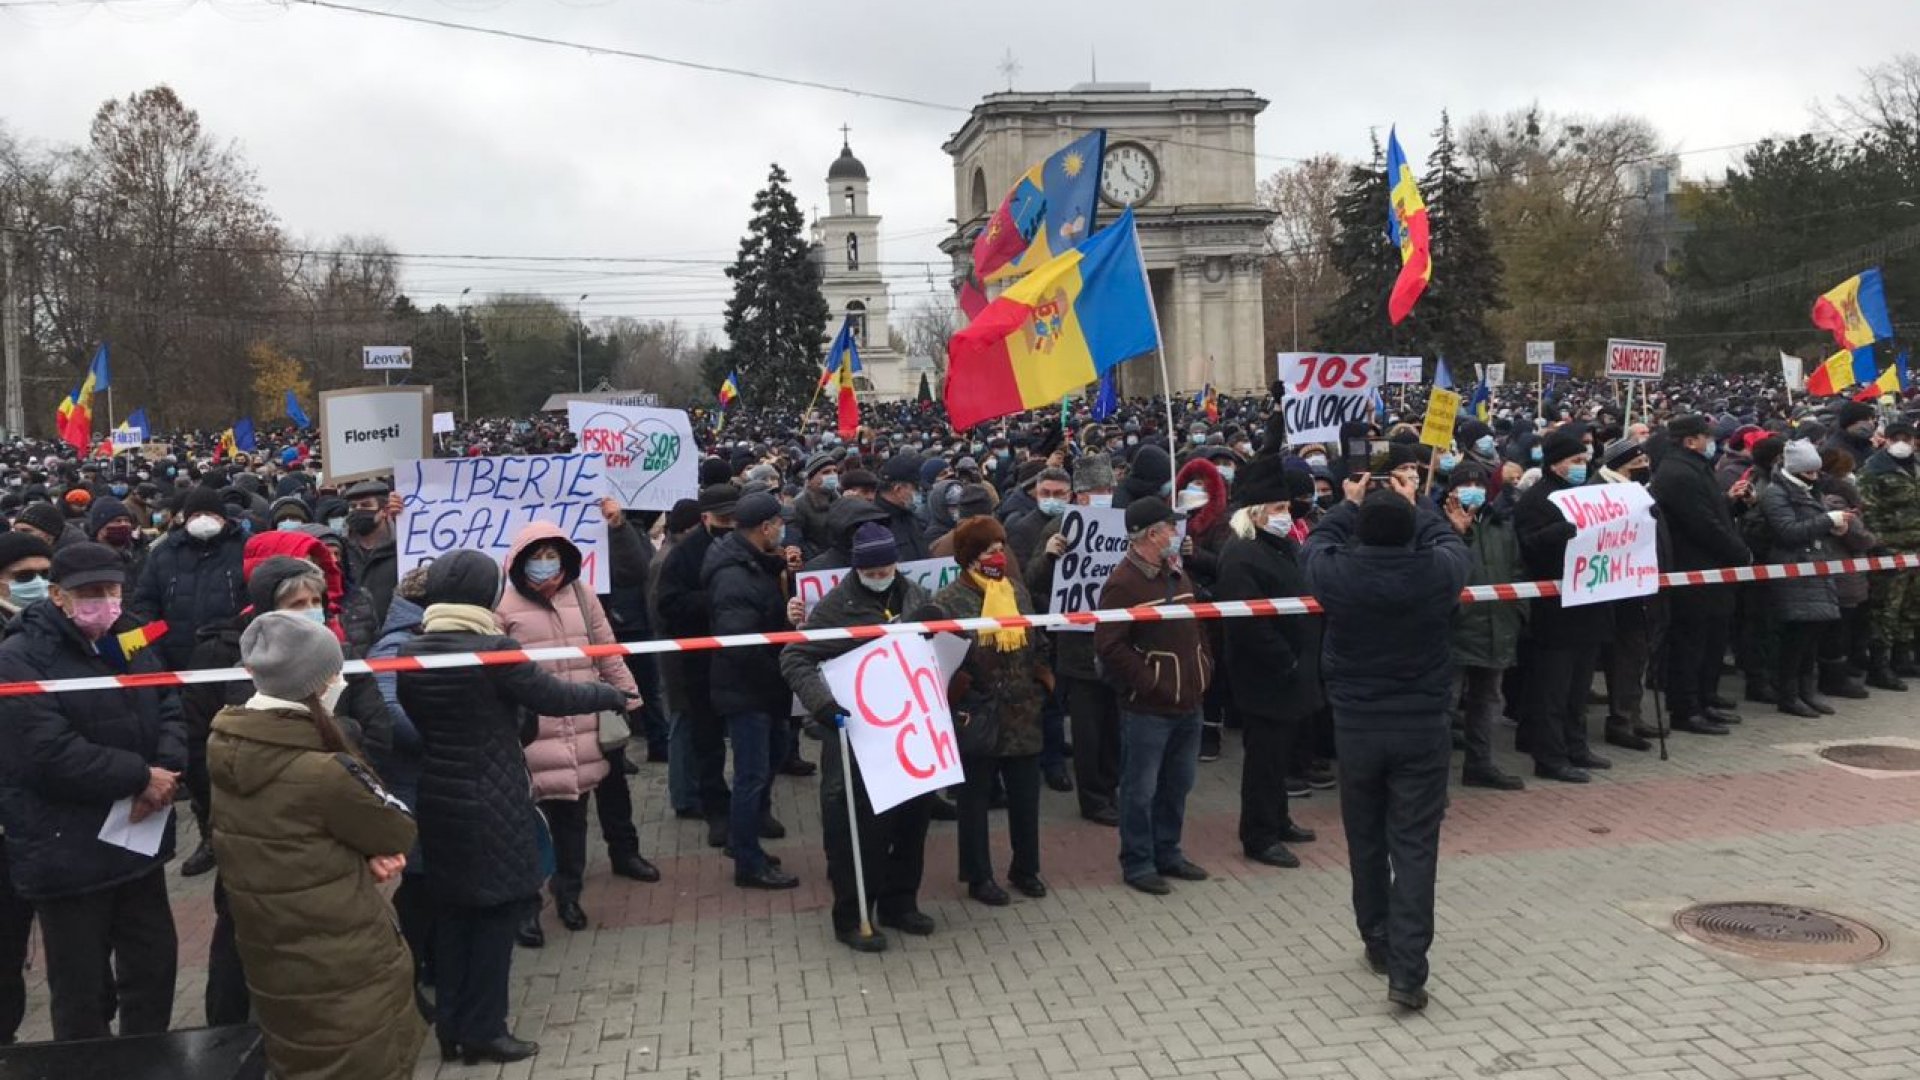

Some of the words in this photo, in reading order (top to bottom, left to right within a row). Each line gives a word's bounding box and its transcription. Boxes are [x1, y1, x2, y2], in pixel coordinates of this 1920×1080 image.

[364, 350, 404, 366] Leova
[1295, 355, 1372, 393] JOS
[345, 424, 400, 444] Florești
[583, 428, 624, 453] PSRM
